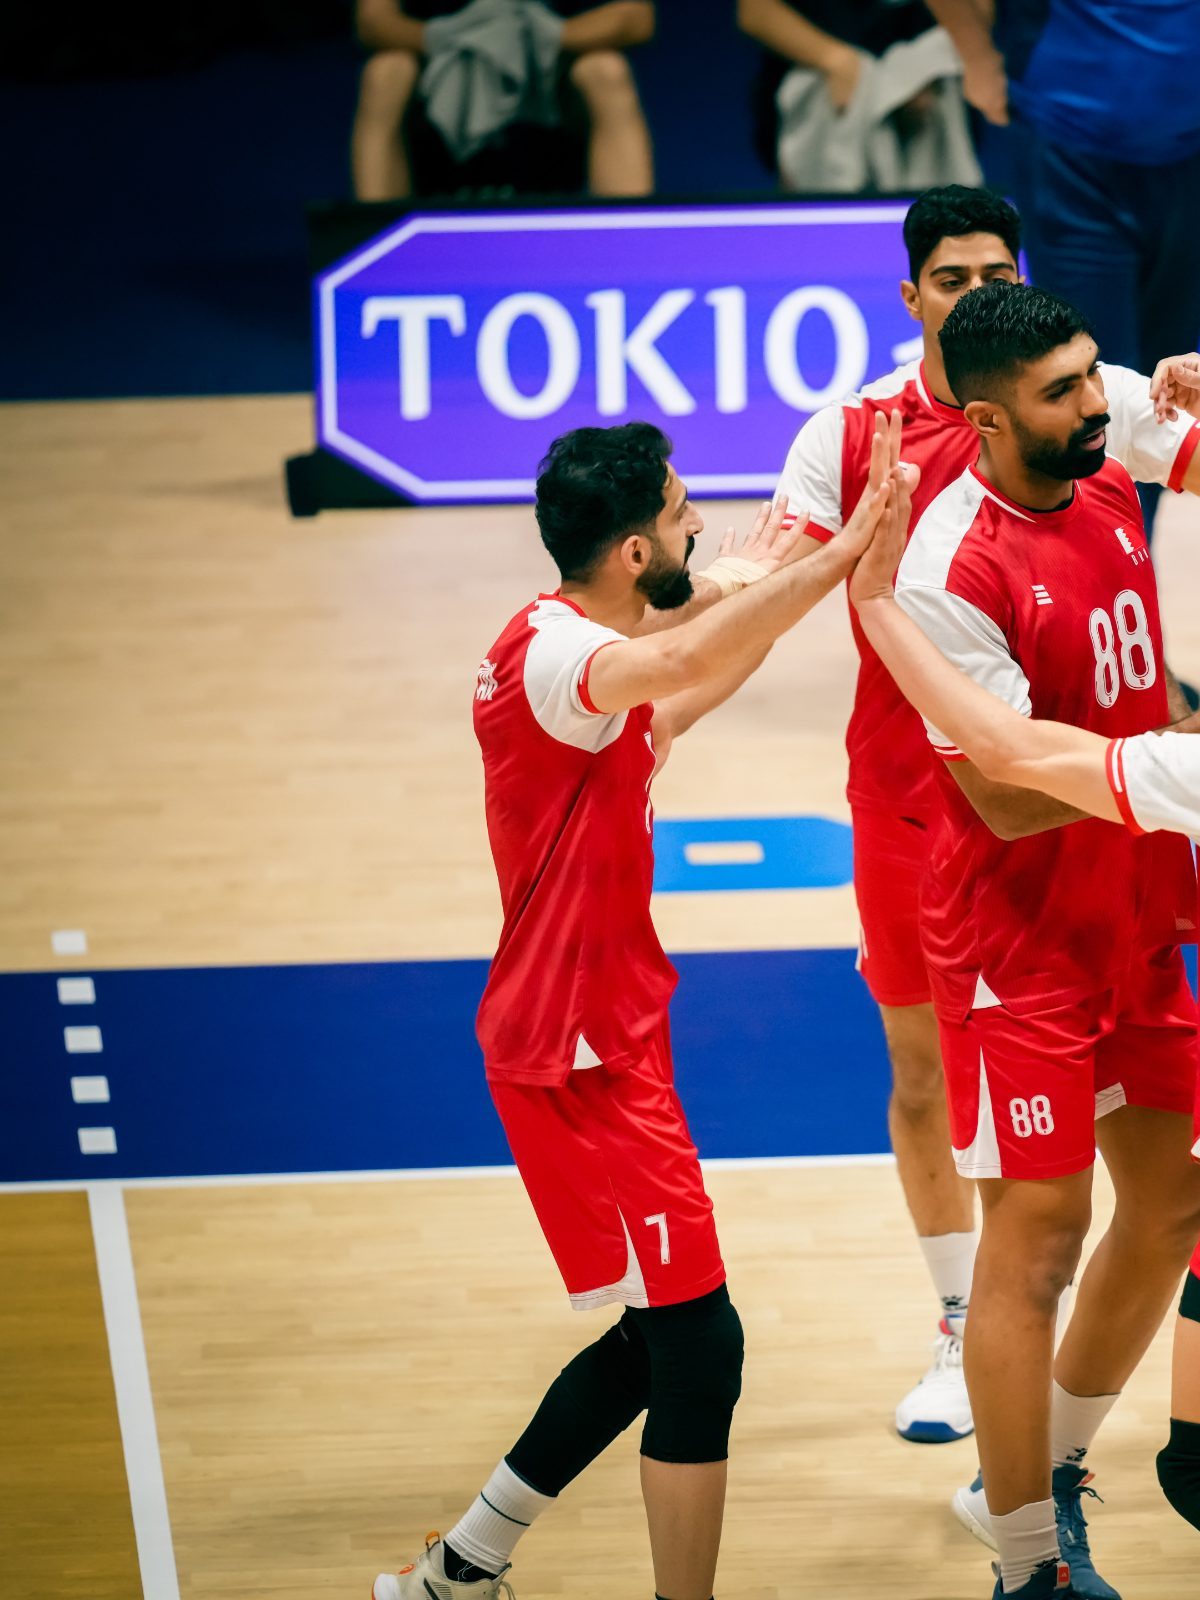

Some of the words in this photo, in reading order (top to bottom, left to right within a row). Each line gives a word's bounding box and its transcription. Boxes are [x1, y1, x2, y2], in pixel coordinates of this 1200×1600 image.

[360, 286, 869, 421] TOKIO
[1088, 589, 1157, 709] 88
[1009, 1094, 1055, 1138] 88
[644, 1211, 671, 1266] 7
